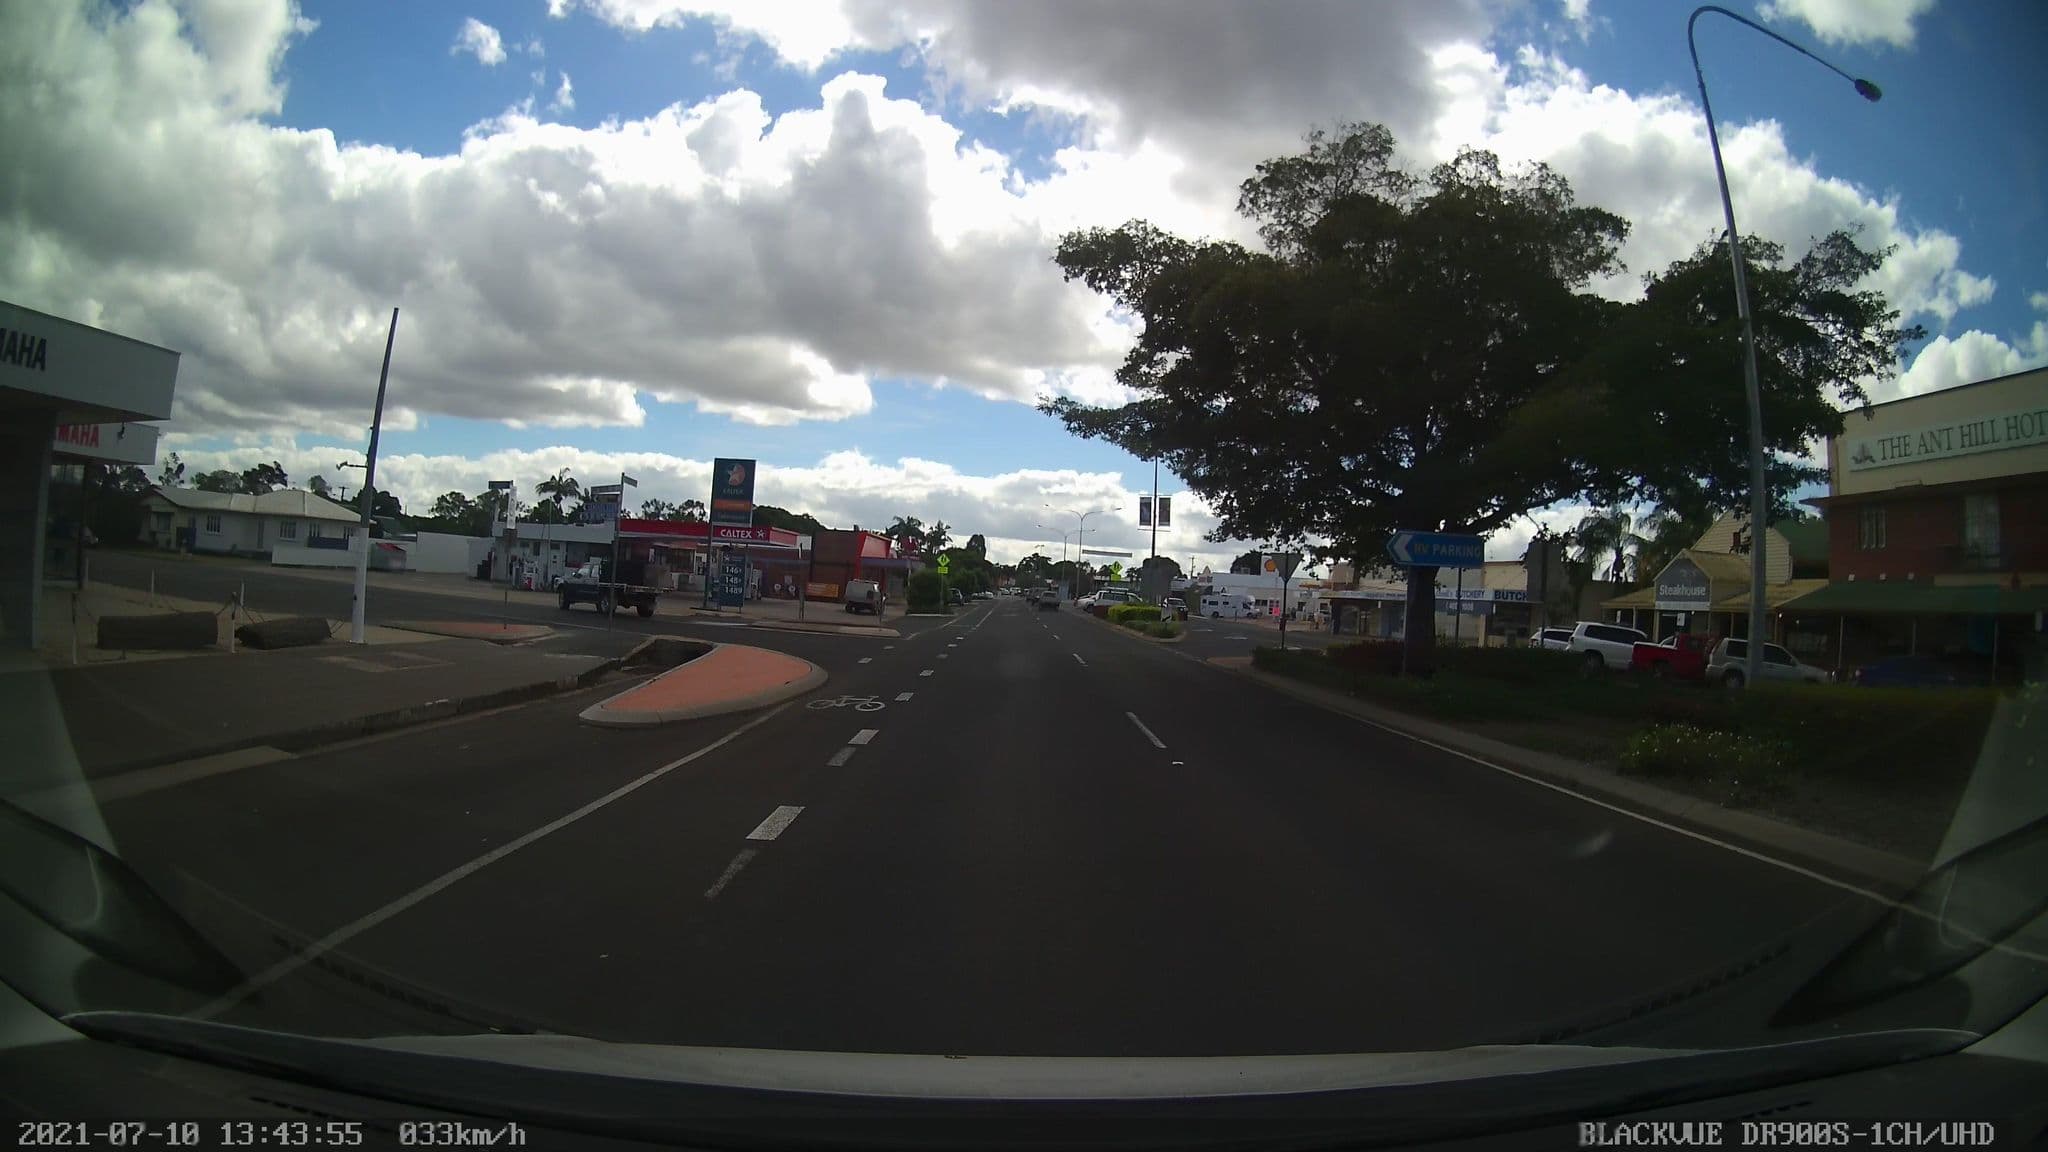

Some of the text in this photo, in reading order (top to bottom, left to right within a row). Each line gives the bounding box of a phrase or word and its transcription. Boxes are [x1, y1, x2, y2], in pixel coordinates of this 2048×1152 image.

[1877, 435, 1912, 460] THE
[1917, 427, 1953, 455] ANT
[1958, 420, 1999, 448] HILL
[720, 528, 752, 539] CALTEX
[1432, 543, 1481, 559] PARKING
[1659, 584, 1706, 597] Steakhouse
